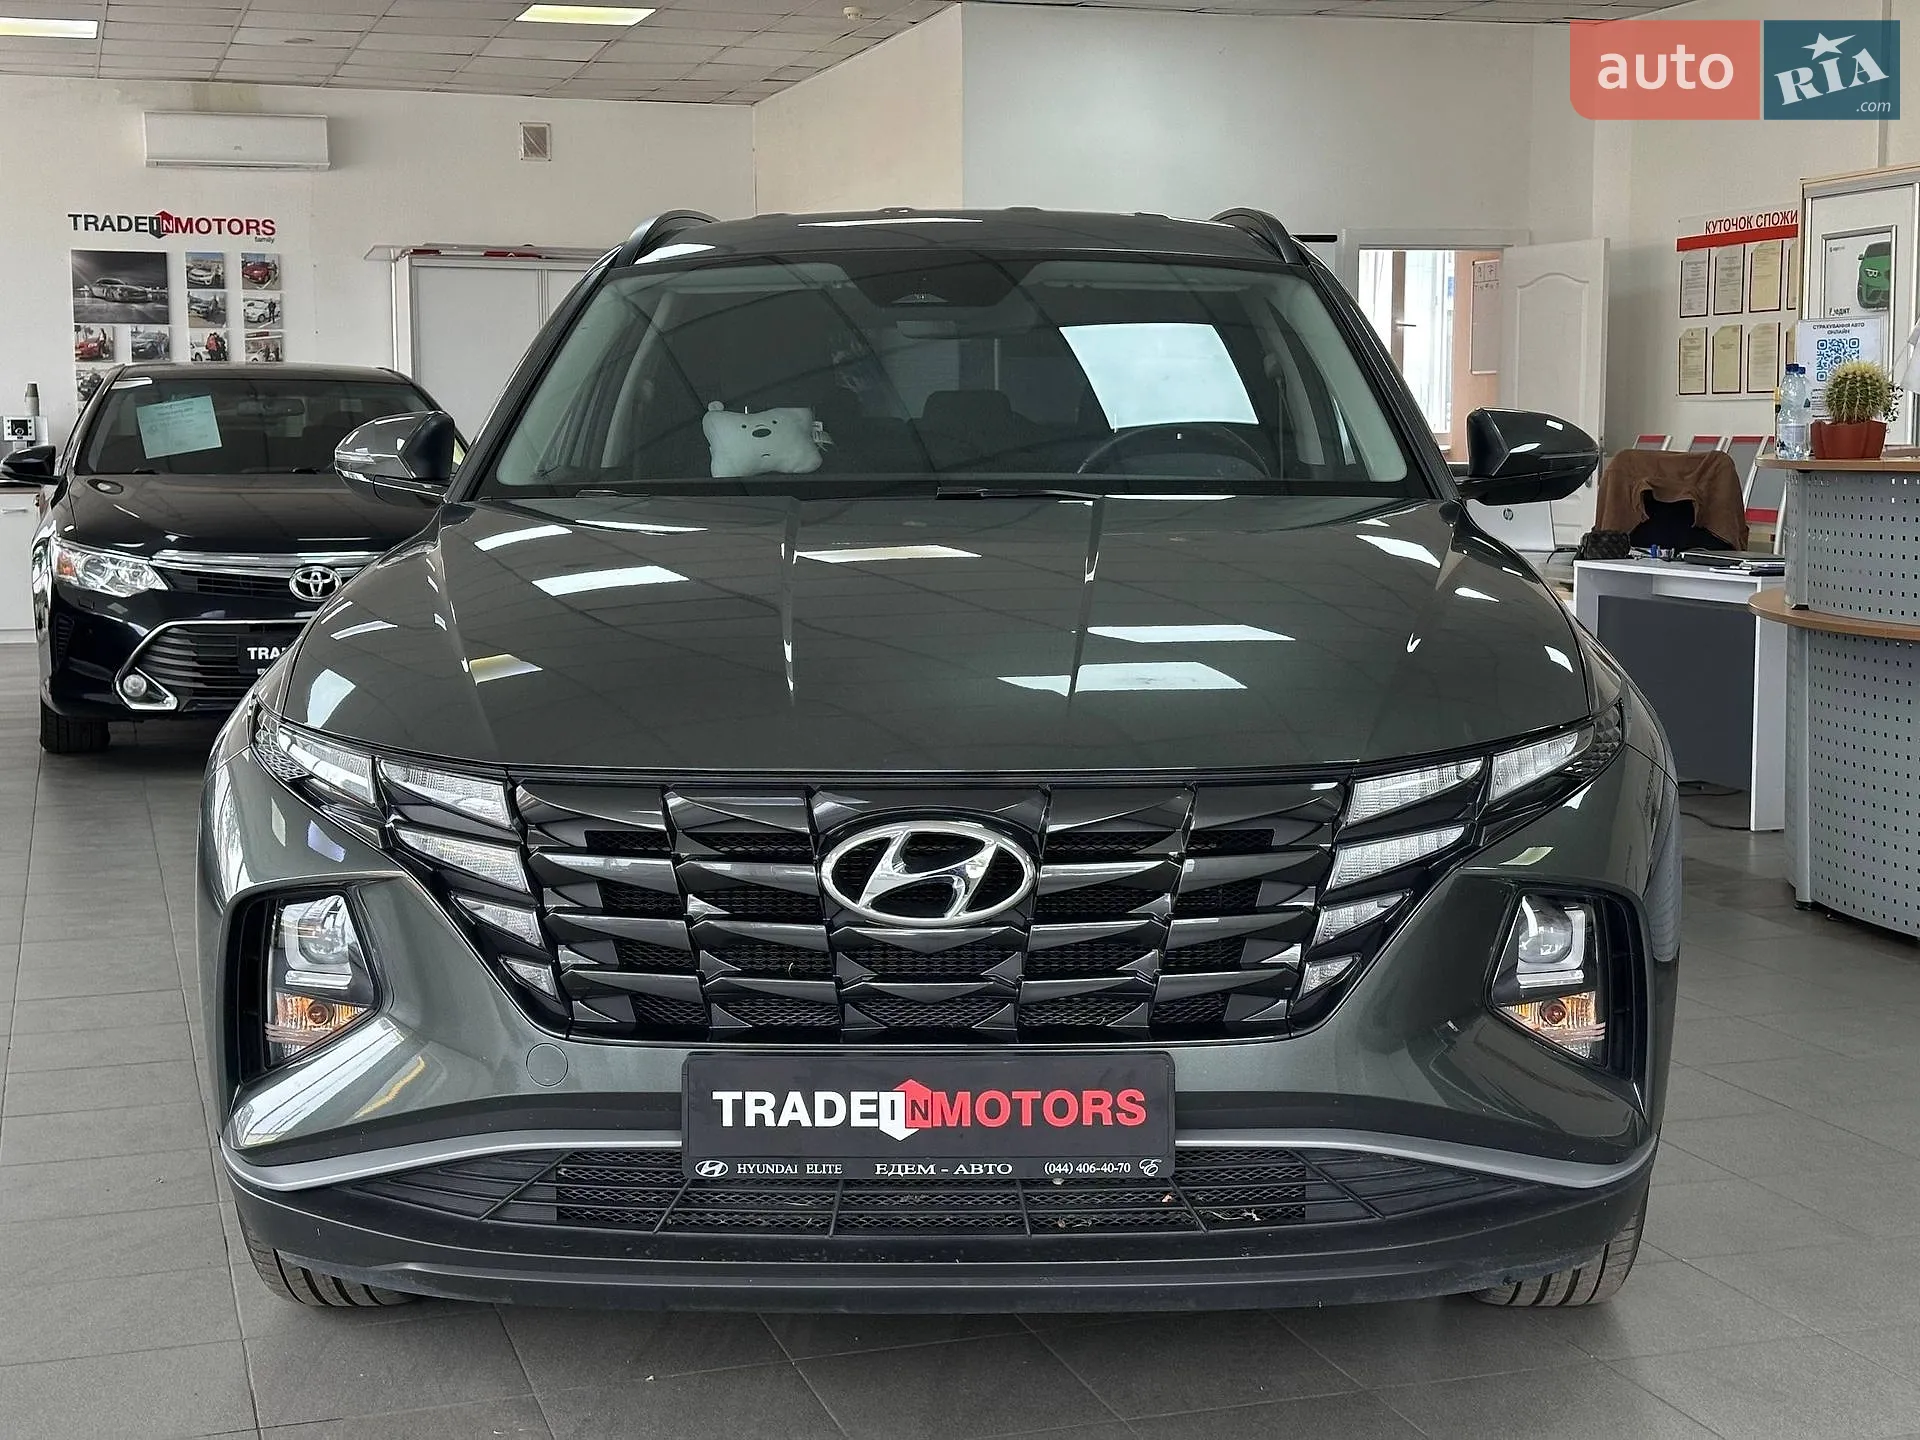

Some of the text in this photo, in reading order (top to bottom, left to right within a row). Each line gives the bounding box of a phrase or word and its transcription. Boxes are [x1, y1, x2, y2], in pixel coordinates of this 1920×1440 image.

[1705, 215, 1753, 234] КУТОЧОК
[254, 236, 275, 244] family
[247, 646, 287, 660] TRA
[737, 1163, 843, 1175] HYUNDAI ELITE
[874, 1163, 937, 1177] ЕДЕМ
[953, 1163, 1013, 1175] АВТО
[1044, 1161, 1074, 1176] (044)
[1075, 1162, 1131, 1175] 406-40-70
